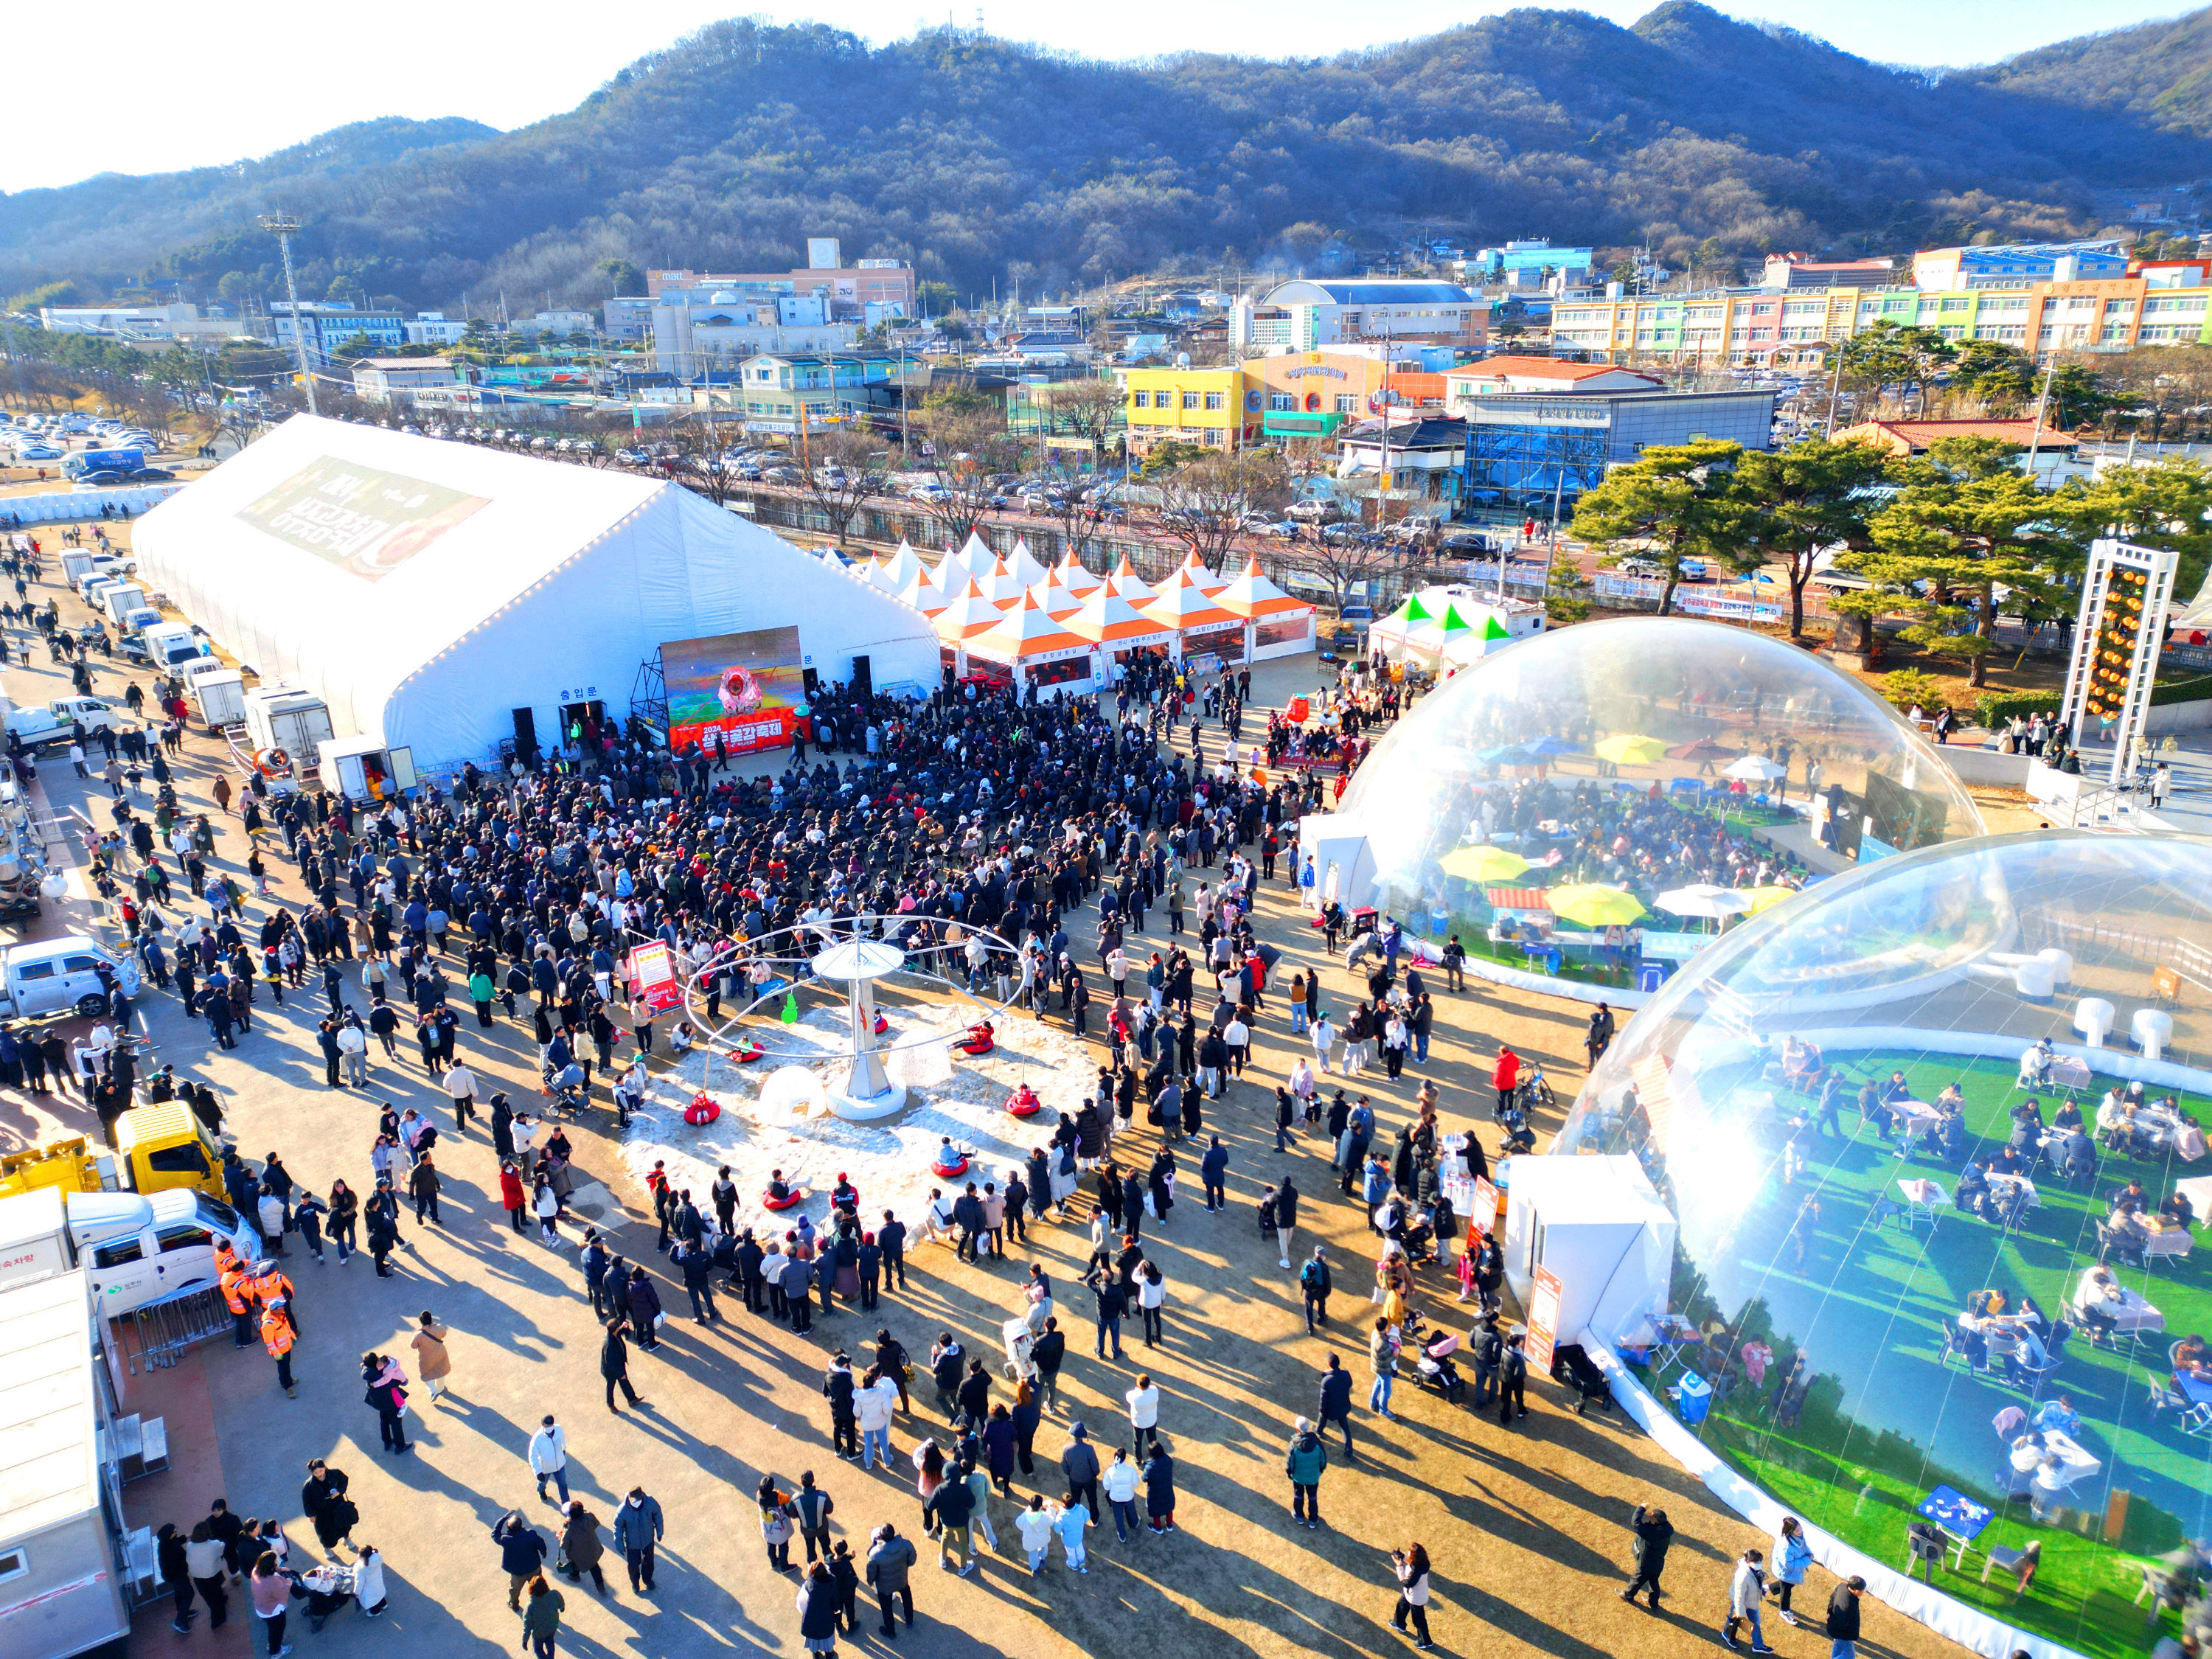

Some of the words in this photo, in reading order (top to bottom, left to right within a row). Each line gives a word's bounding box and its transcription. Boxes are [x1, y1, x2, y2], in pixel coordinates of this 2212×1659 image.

[655, 271, 684, 281] emart
[560, 686, 597, 700] 출입문
[703, 725, 722, 734] 2024
[0, 1253, 34, 1270] 속차량
